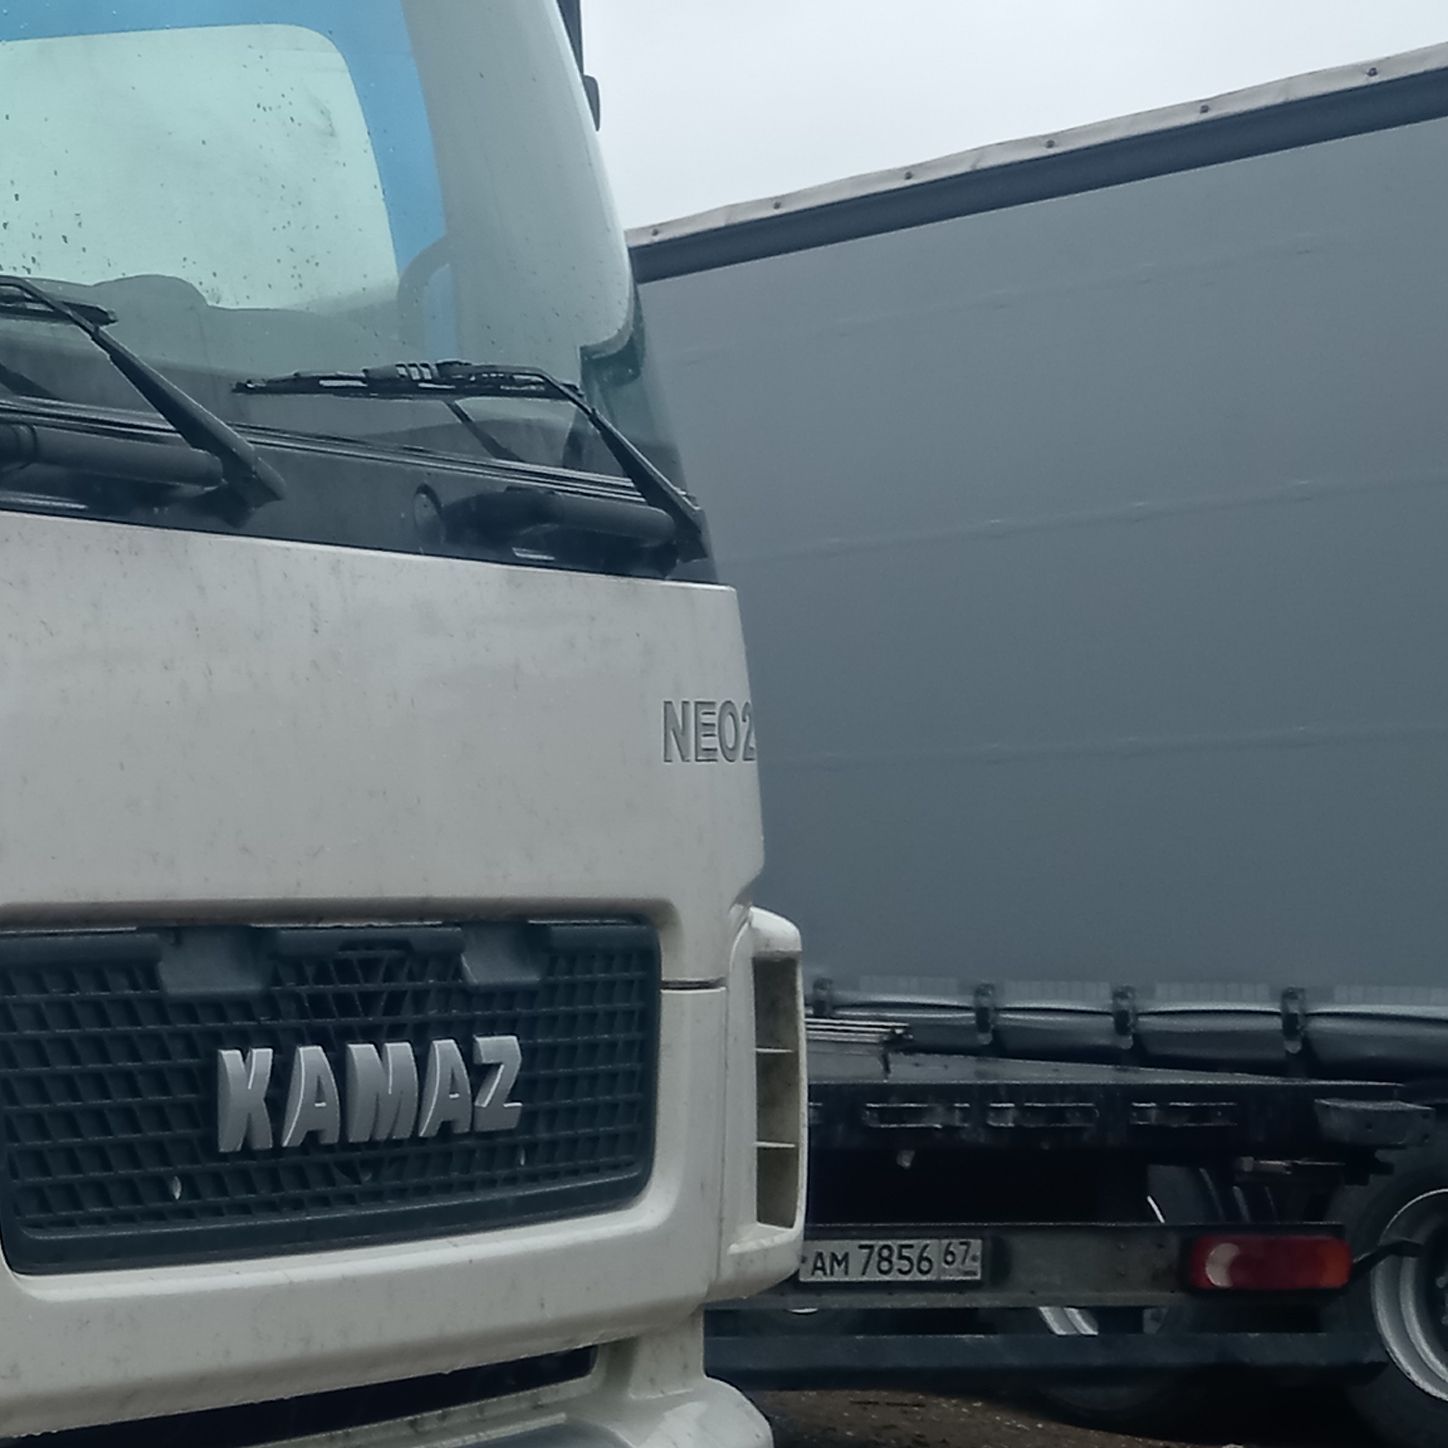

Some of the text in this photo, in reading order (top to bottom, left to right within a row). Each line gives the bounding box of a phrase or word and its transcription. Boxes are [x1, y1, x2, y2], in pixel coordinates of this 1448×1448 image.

[663, 700, 756, 763] NEO2
[217, 1034, 523, 1152] KAMAZ
[857, 1244, 934, 1276] 7856
[942, 1241, 972, 1266] 67
